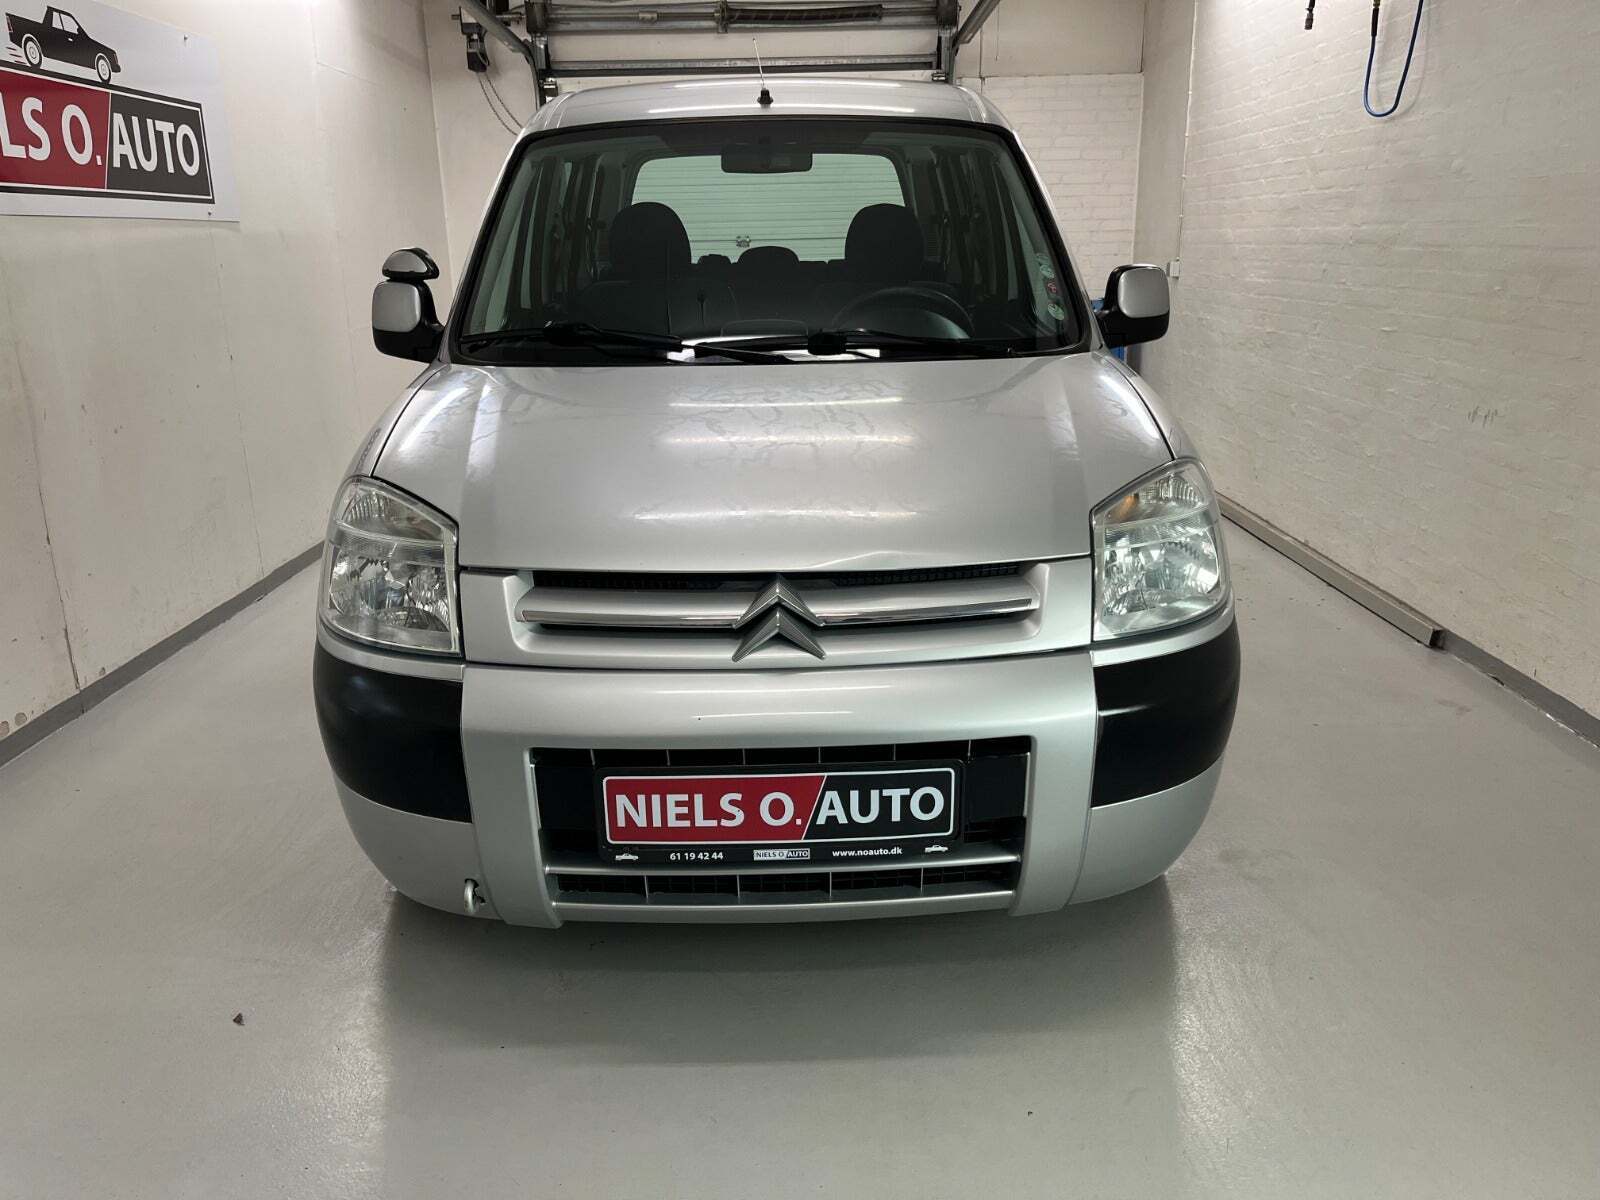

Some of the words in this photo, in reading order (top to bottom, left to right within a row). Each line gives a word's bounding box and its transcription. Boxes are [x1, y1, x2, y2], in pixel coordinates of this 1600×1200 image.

[61, 104, 102, 165] O.
[112, 112, 200, 176] AUTO
[615, 793, 745, 828] NIELS
[759, 791, 802, 826] O.
[815, 786, 945, 825] AUTO
[669, 852, 681, 861] 61
[684, 852, 696, 861] 19
[697, 852, 709, 861] 42
[711, 851, 724, 860] 44
[755, 850, 778, 859] NIELS
[787, 849, 809, 858] AUTO
[832, 846, 903, 857] www.noauto.dk
